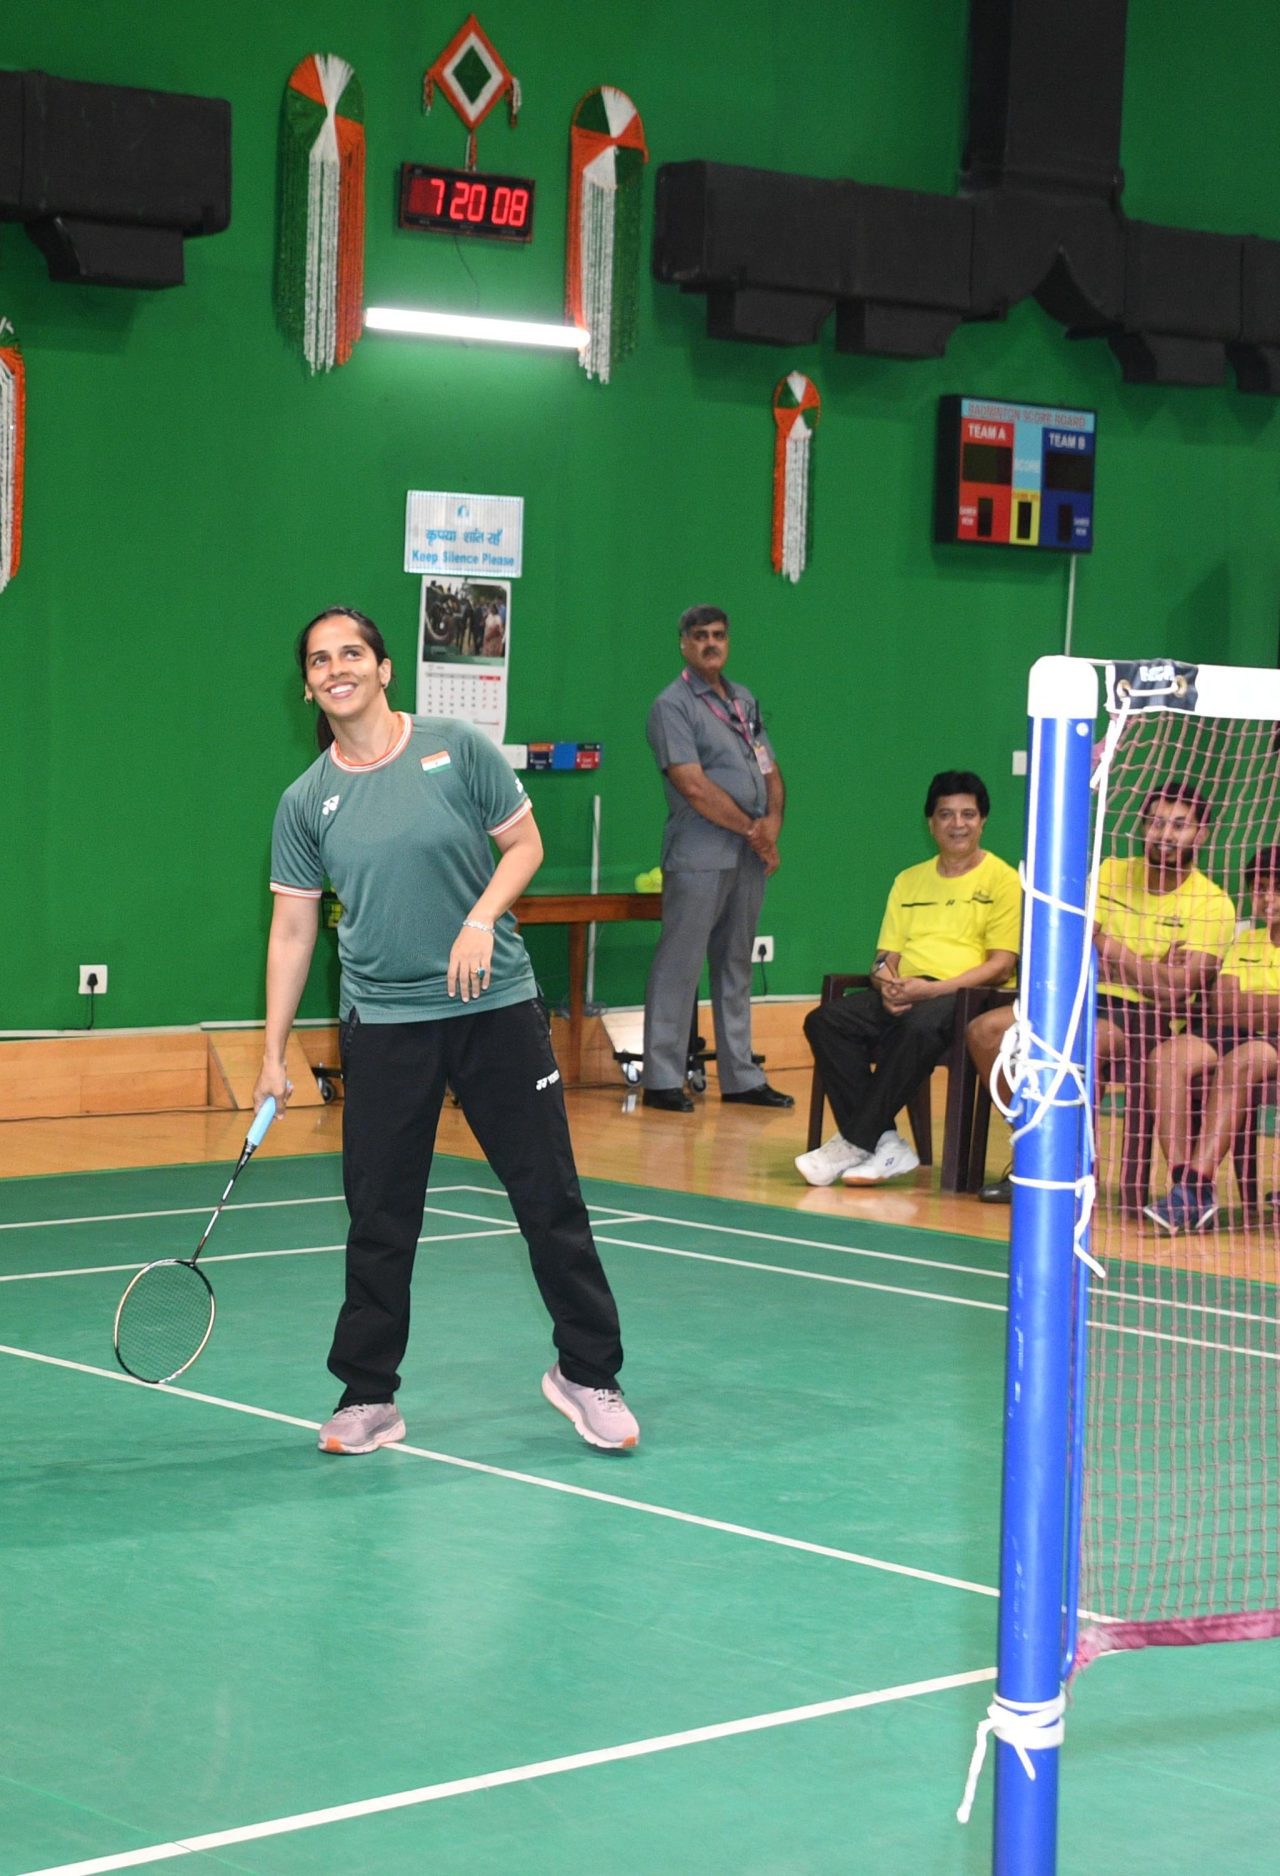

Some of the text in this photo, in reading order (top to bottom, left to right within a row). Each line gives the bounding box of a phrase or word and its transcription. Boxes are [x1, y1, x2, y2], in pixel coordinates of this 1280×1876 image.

[430, 178, 529, 227] 7 20 08
[969, 424, 1006, 440] TEAM A
[1049, 433, 1076, 449] TEAM
[412, 550, 515, 567] Keep Silence Please
